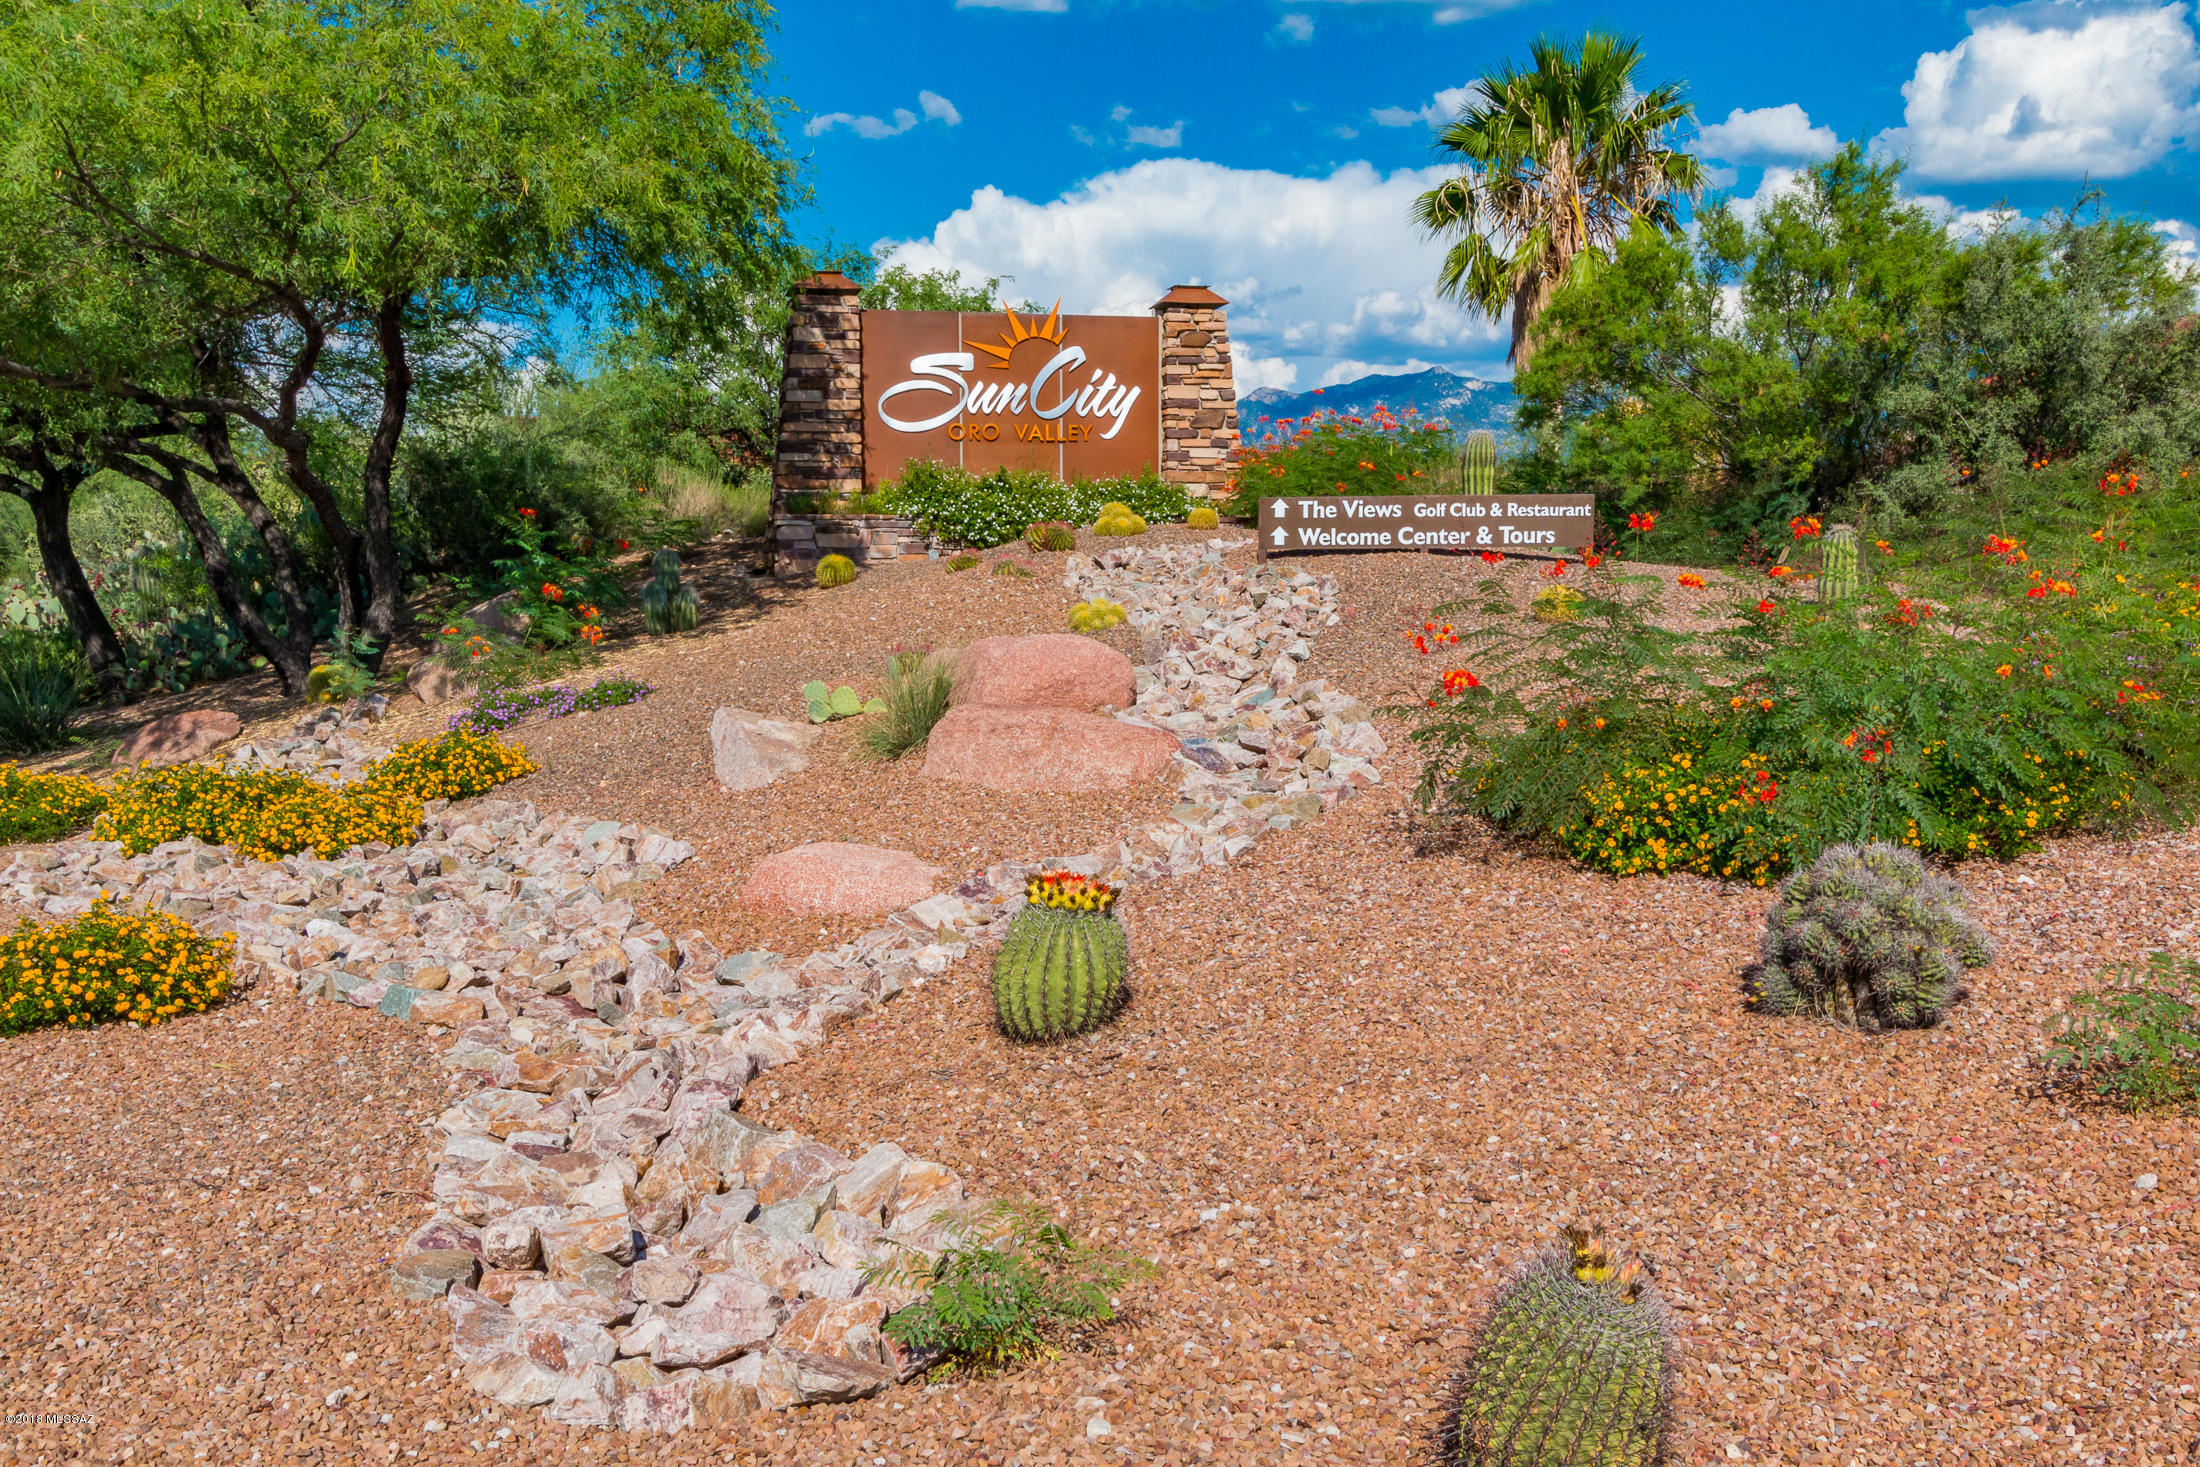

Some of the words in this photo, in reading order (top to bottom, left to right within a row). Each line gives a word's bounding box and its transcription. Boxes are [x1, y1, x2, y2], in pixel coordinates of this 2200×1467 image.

[878, 352, 1028, 433] Sun
[1030, 346, 1142, 440] City
[948, 423, 1000, 442] ORO
[1013, 423, 1093, 442] VALLEY
[1298, 500, 1337, 518] The
[1342, 500, 1402, 518] Views
[1414, 502, 1446, 517] Golf
[1450, 503, 1486, 517] Club
[1490, 503, 1503, 517] &
[1507, 503, 1592, 517] Restaurant
[1298, 527, 1392, 546] Welcome
[1398, 526, 1470, 545] Center
[1476, 526, 1493, 545] &
[1499, 526, 1556, 544] Tours
